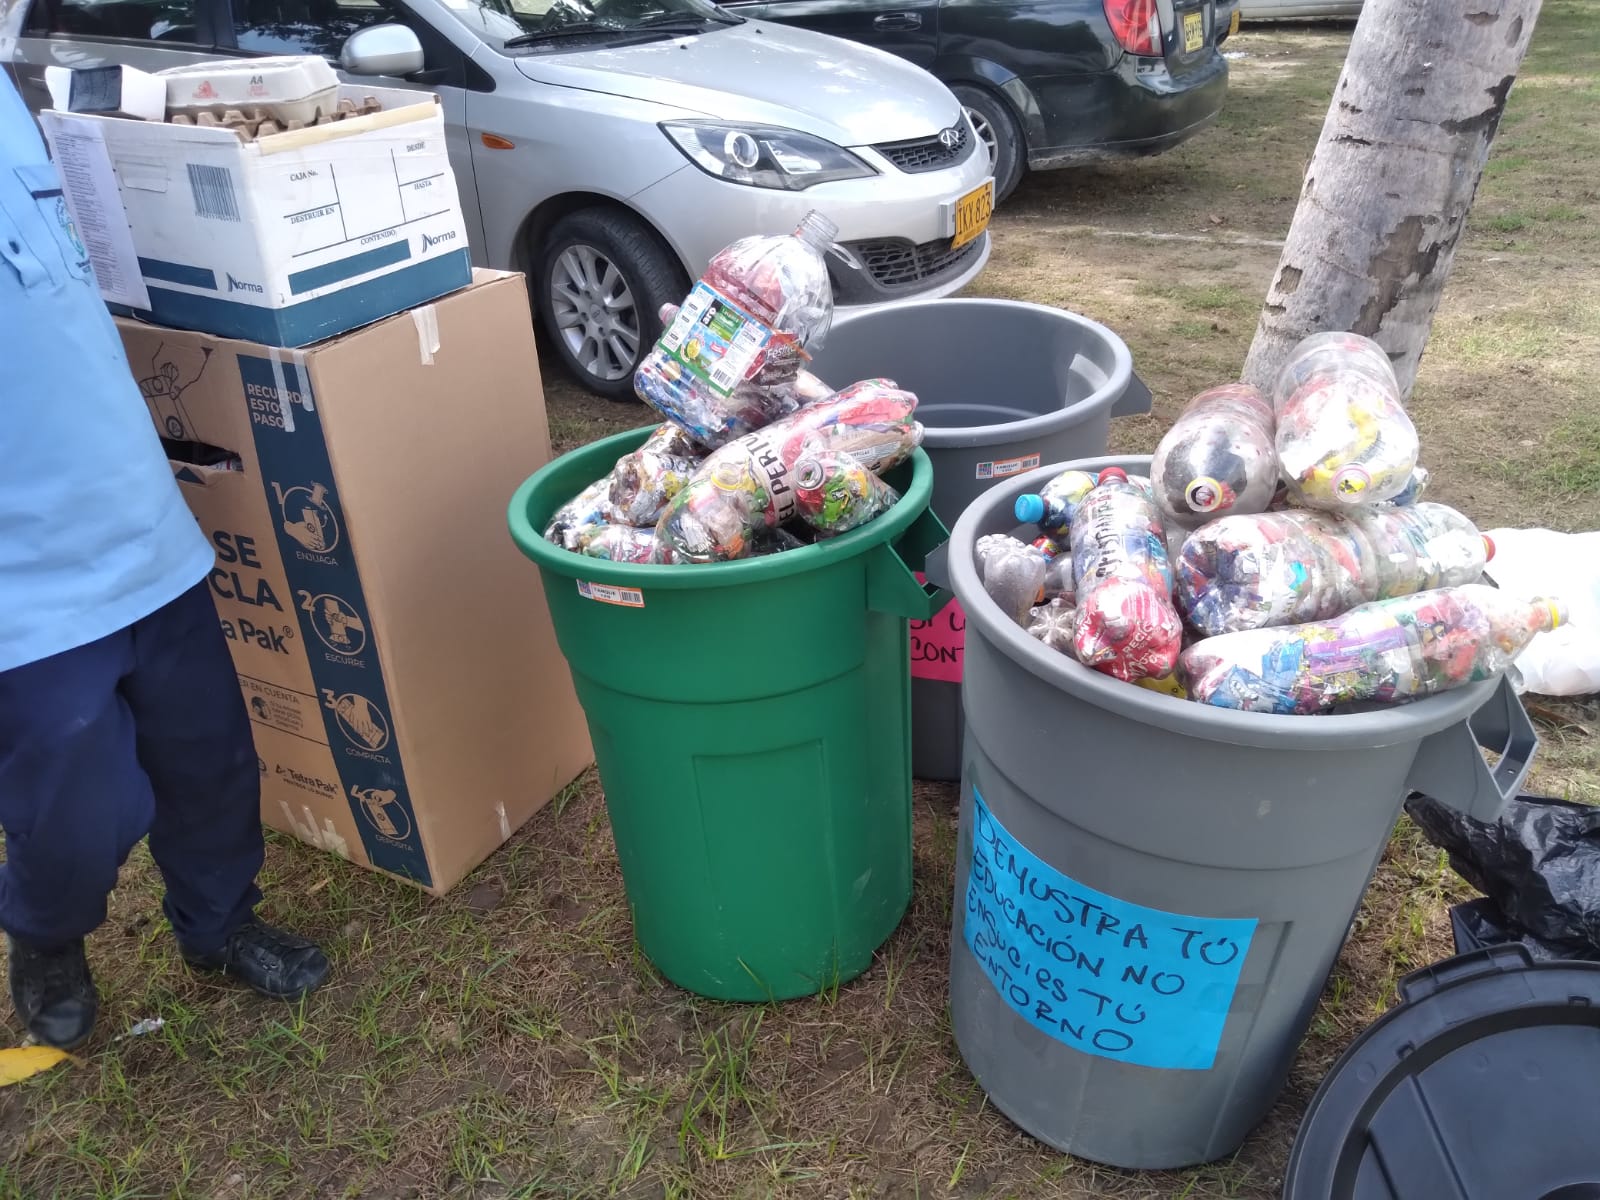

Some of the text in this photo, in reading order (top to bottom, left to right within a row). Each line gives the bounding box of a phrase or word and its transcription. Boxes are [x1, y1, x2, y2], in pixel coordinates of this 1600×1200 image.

[291, 210, 324, 224] DESTRUIR
[360, 229, 397, 245] CONTENIDO
[422, 230, 456, 253] Norma
[226, 272, 264, 293] Norma
[247, 384, 312, 406] RECURD
[250, 398, 287, 416] ESTO
[253, 412, 288, 430] PASO
[295, 551, 339, 566] ENJUAGA
[209, 567, 284, 612] CLA
[325, 653, 366, 668] ESCURRE
[263, 687, 300, 704] CUENTA
[345, 747, 392, 764] COMPACTA
[375, 834, 415, 851] DEPOSITA
[973, 846, 1185, 995] EDUCACIÓN NO
[973, 931, 1134, 1051] ENTORNO
[1078, 988, 1146, 1025] TÚ
